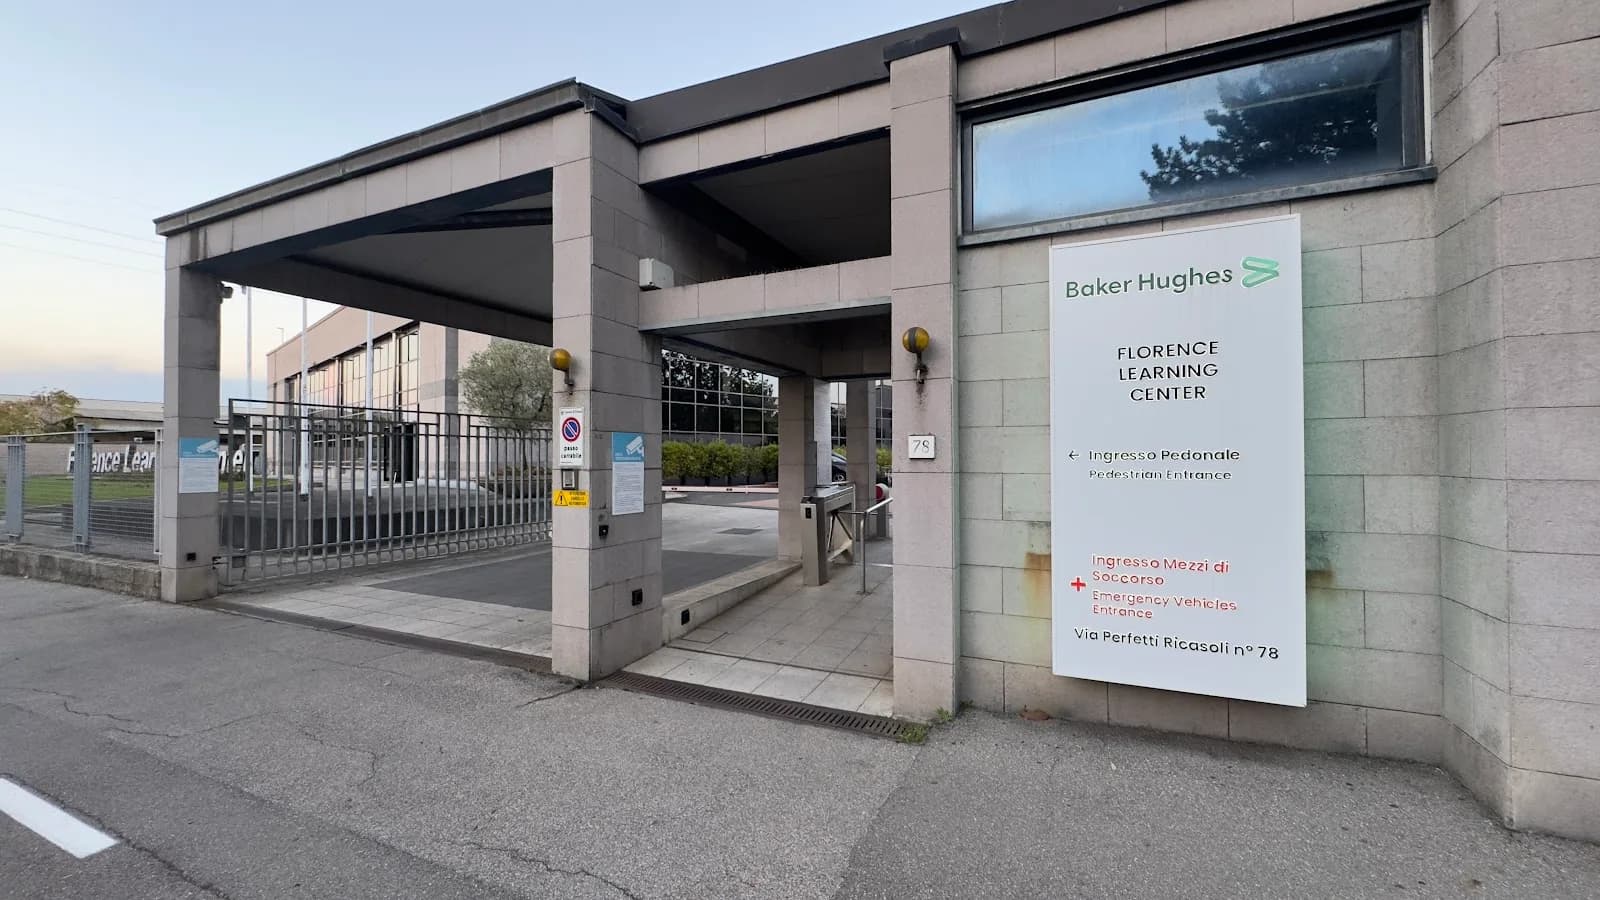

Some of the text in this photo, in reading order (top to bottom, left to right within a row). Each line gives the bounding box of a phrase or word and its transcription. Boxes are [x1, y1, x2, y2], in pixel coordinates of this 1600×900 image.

[1066, 267, 1233, 298] Baker Hughes
[1117, 341, 1219, 360] FLORENCE
[1119, 363, 1218, 381] LEARNING
[1130, 386, 1206, 401] CENTER
[912, 440, 930, 453] 78
[1089, 449, 1240, 463] Ingresso Pedonale
[1089, 470, 1232, 480] Pedestrian Entrance
[1092, 555, 1229, 573] Ingresso Mezzi di
[1092, 571, 1164, 585] Soccorso
[1092, 590, 1237, 611] Emergency Vehicles
[1093, 605, 1153, 618] Entrance
[1074, 628, 1098, 640] Via
[1103, 631, 1158, 646] Perfetti
[1164, 637, 1228, 654] Ricasoli
[1258, 646, 1279, 659] 78
